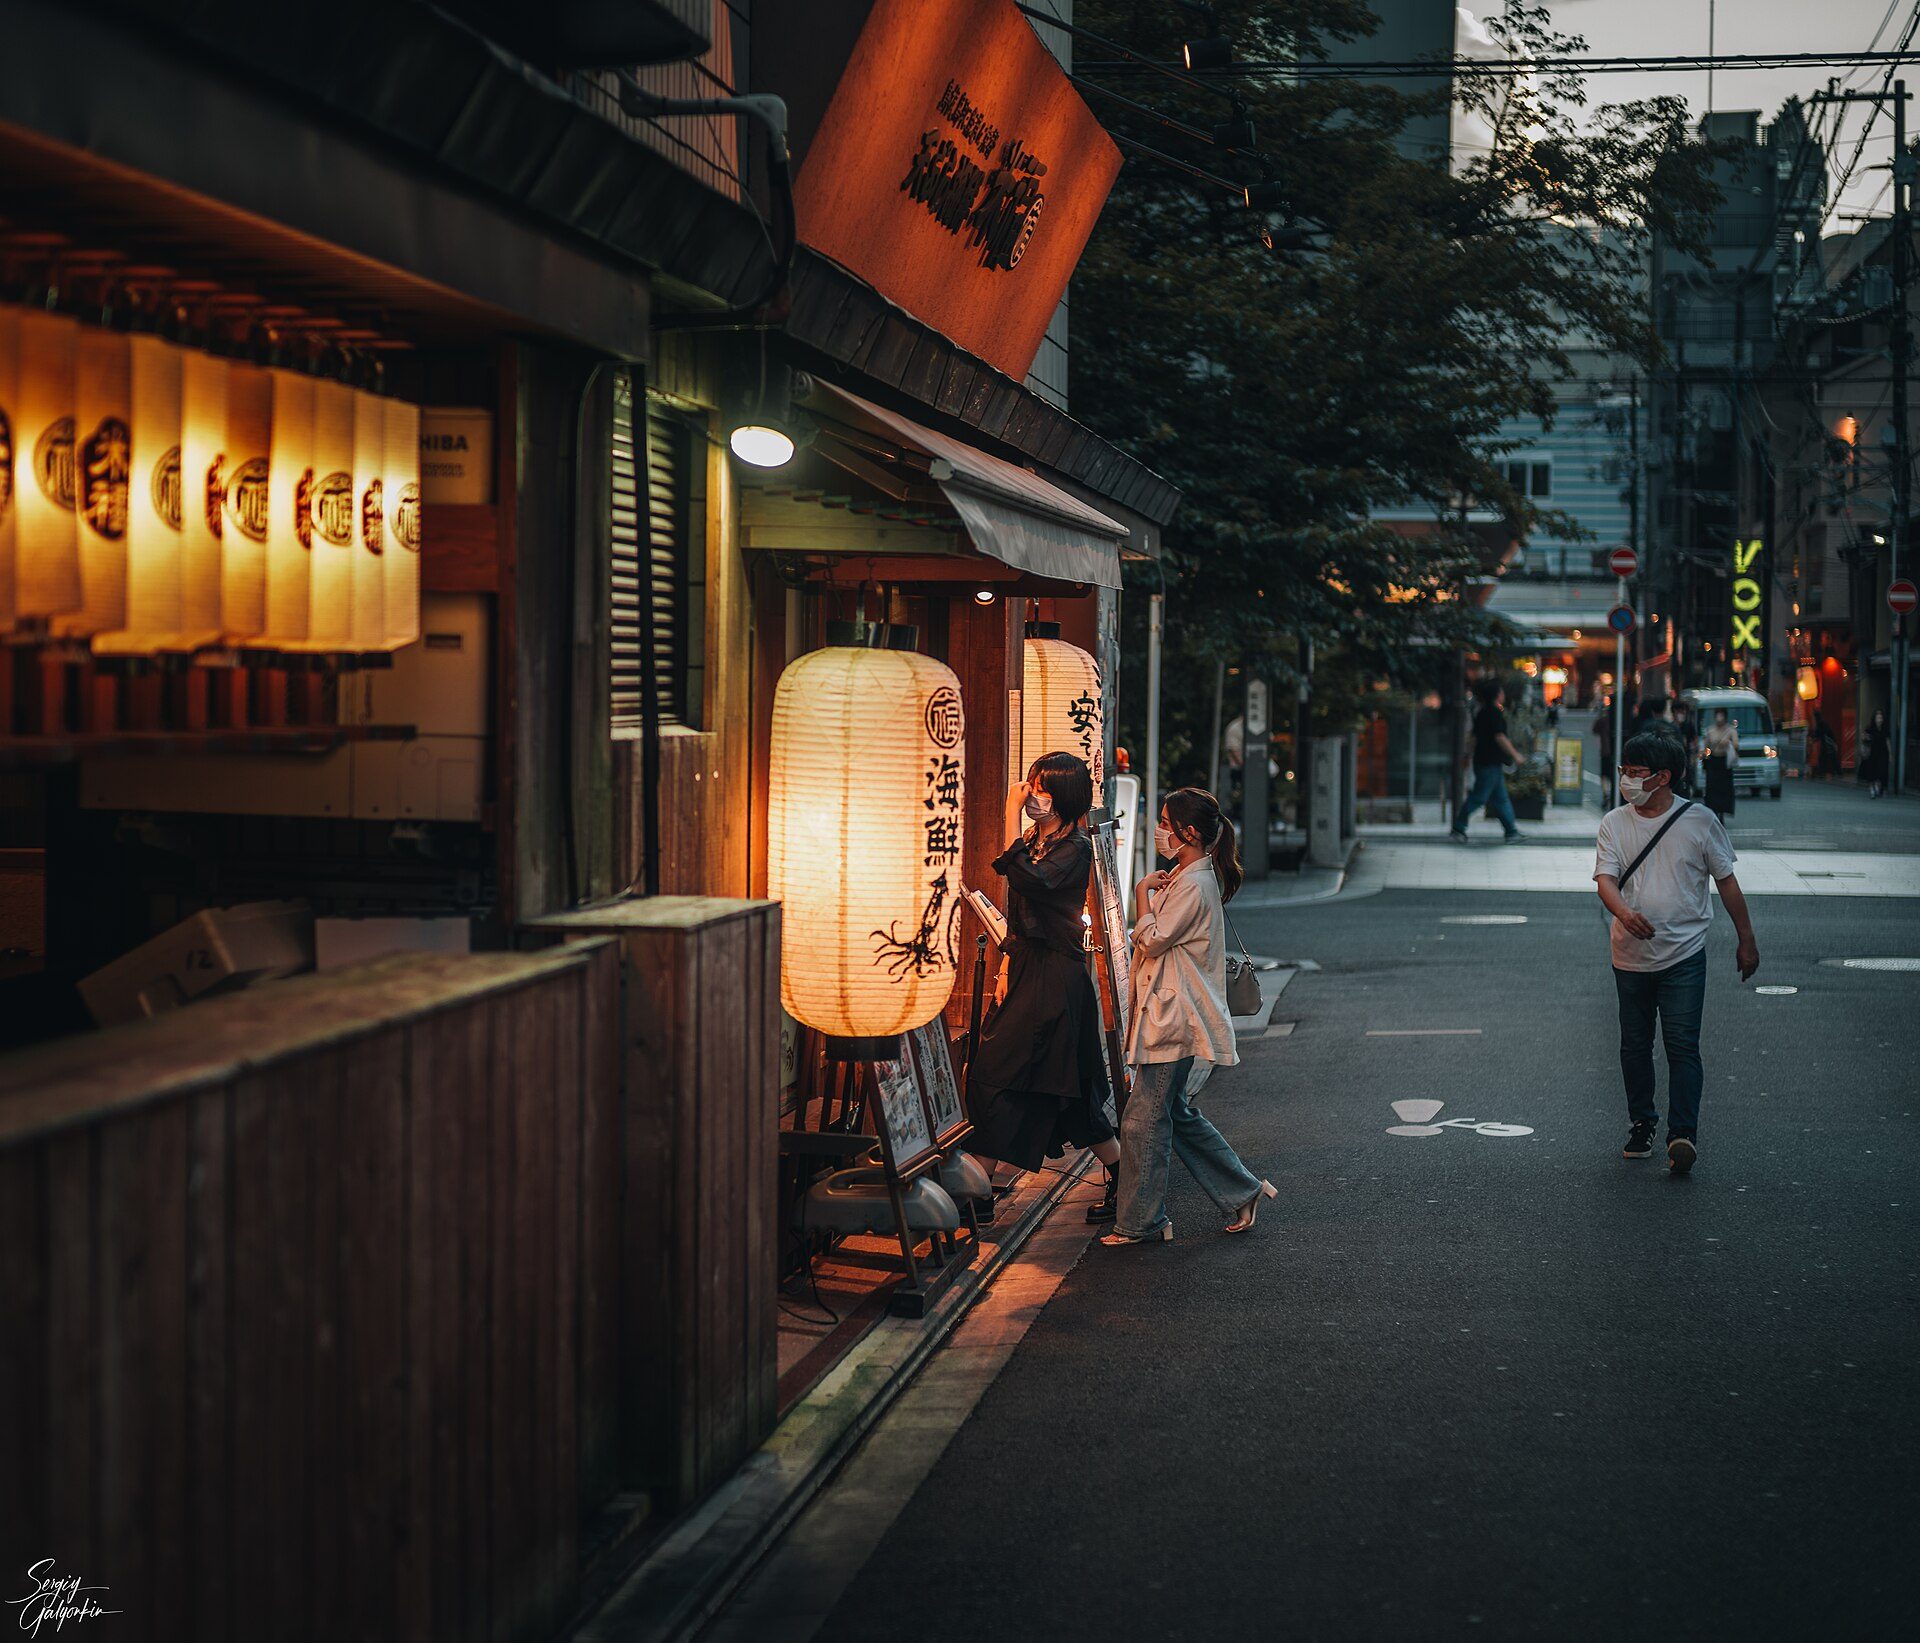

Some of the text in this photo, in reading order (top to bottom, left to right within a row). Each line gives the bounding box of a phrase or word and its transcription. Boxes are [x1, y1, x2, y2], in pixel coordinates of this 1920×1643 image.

[1732, 540, 1763, 649] VOX
[926, 687, 964, 748] 福
[1068, 690, 1097, 775] 安くて
[924, 754, 960, 866] 海鮮
